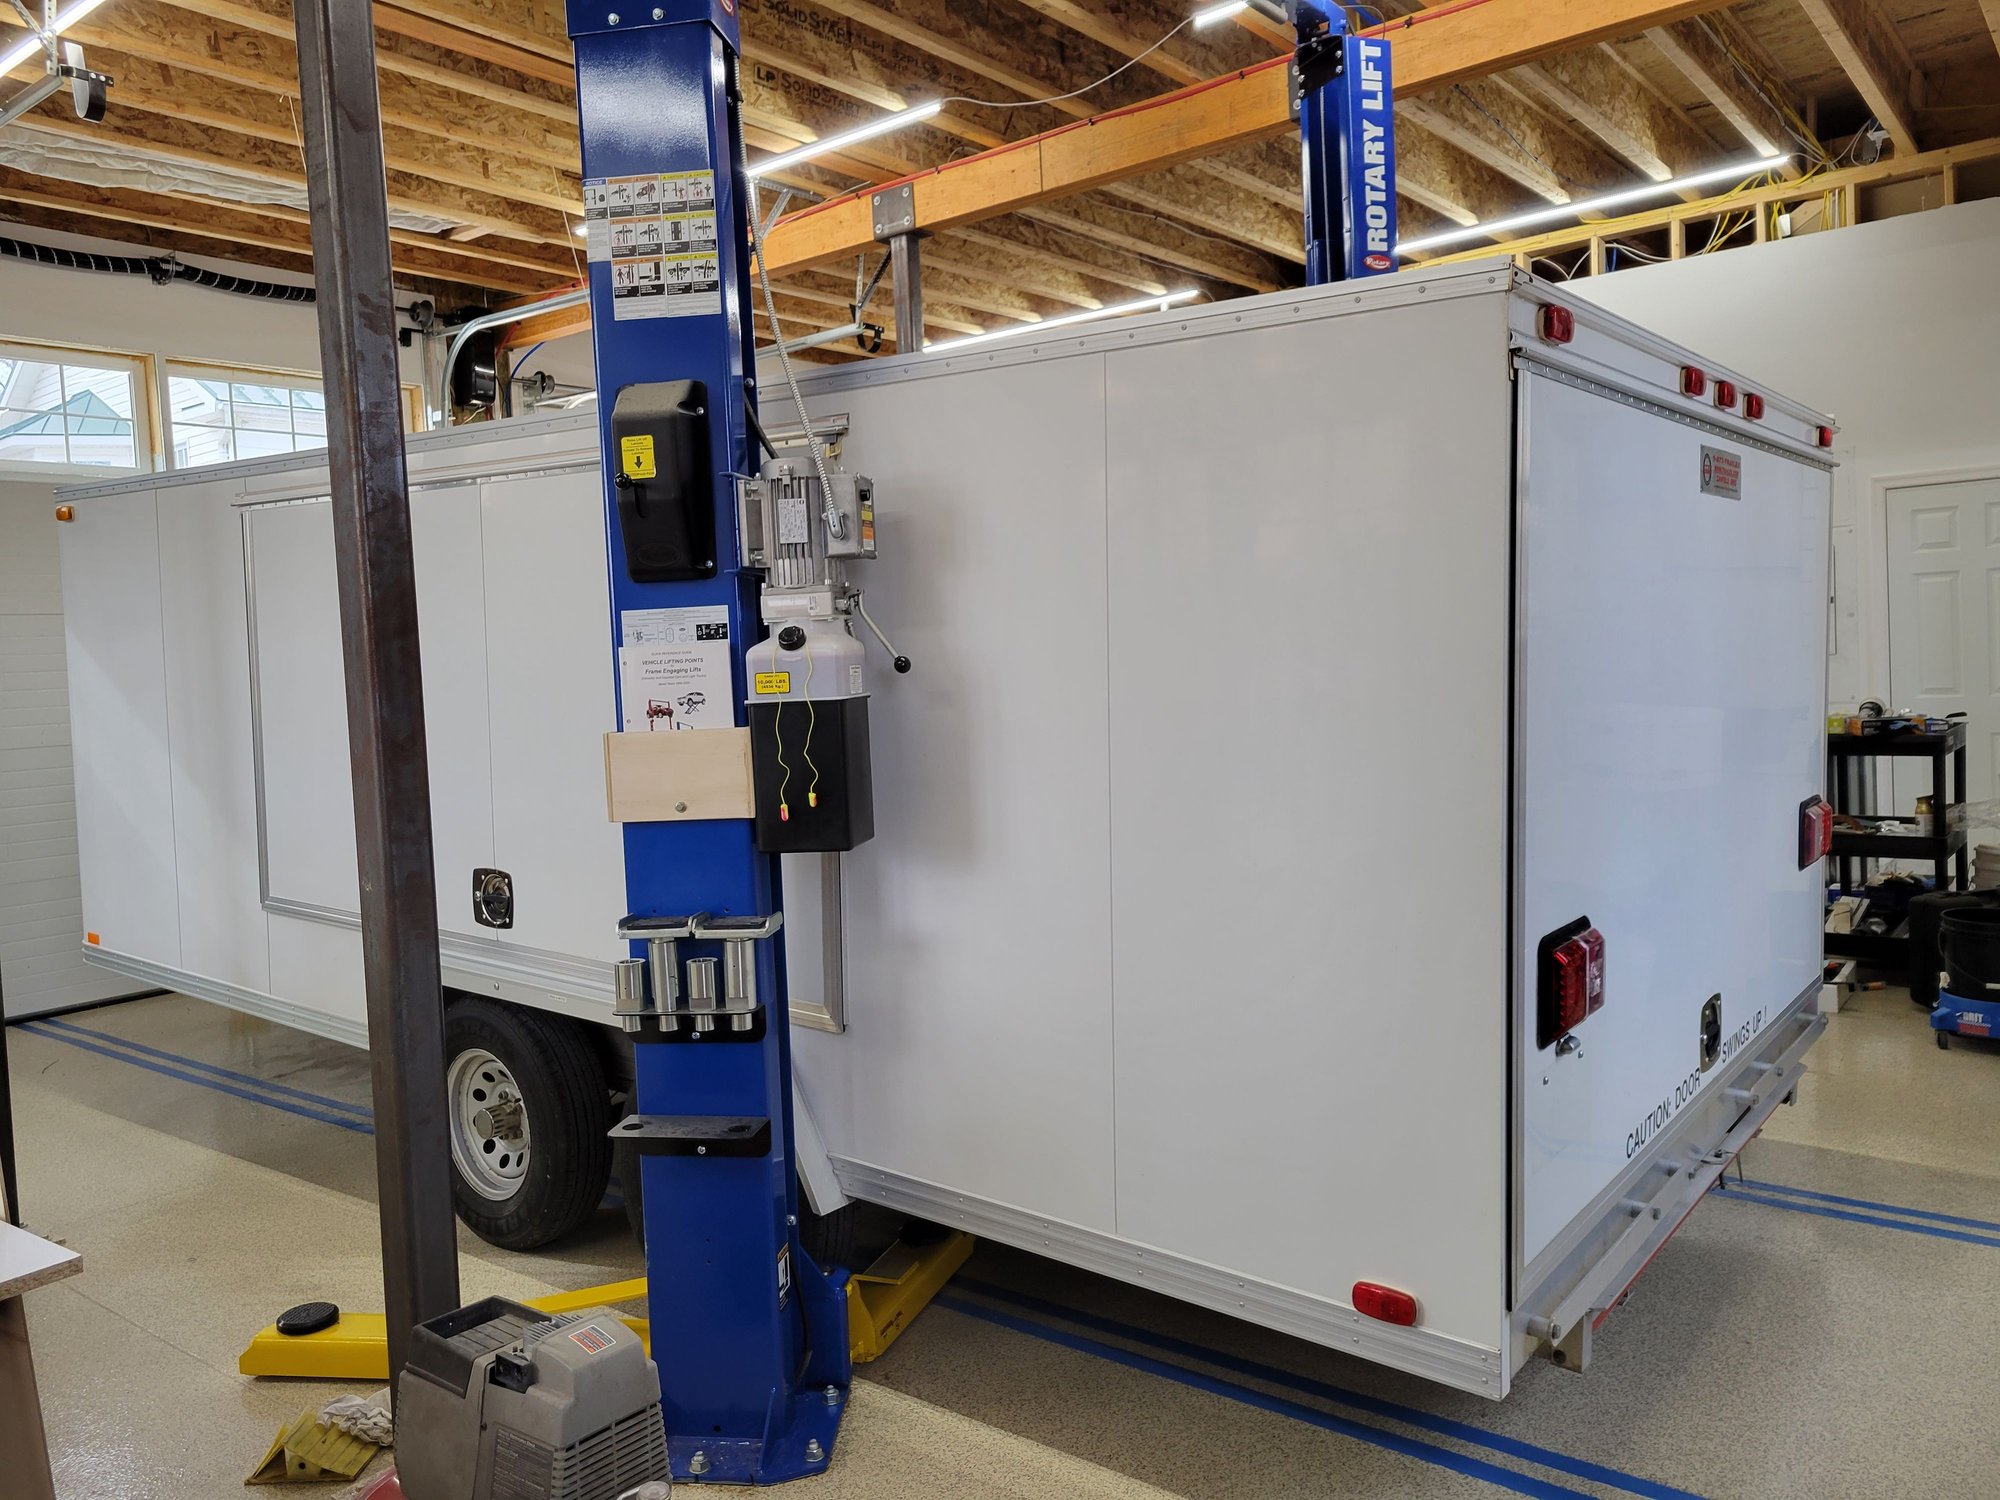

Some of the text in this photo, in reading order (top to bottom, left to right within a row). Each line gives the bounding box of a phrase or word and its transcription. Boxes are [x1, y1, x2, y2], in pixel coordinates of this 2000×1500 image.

[756, 66, 776, 83] LP
[1360, 40, 1388, 252] ROTARY LIFT
[1675, 1067, 1701, 1111] DOOR
[1721, 1019, 1750, 1064] SWINGS
[1752, 1010, 1762, 1034] UP
